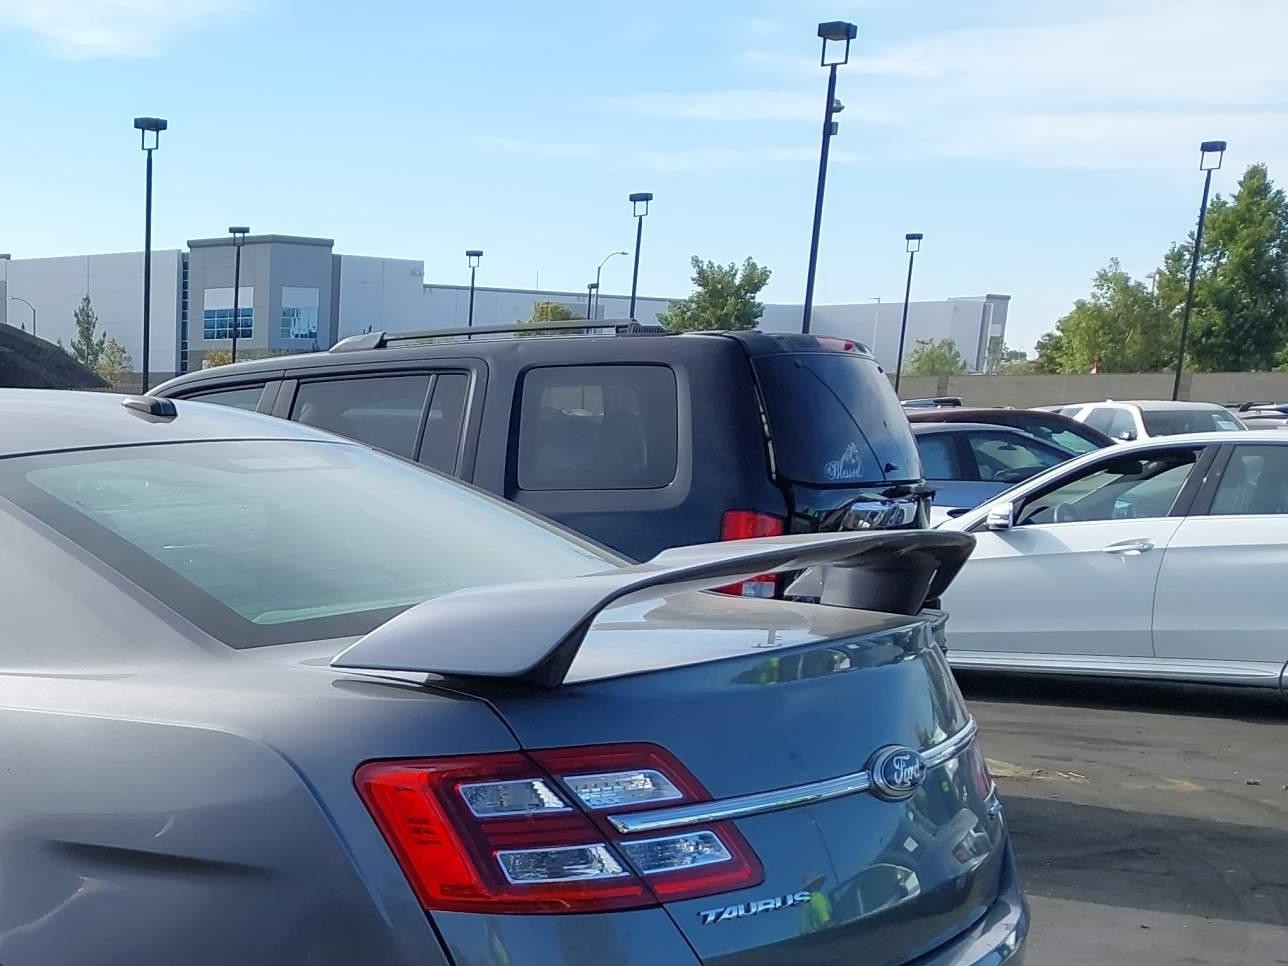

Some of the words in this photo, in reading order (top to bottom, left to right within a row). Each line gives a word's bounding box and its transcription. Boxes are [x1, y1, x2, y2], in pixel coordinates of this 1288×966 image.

[824, 458, 864, 480] Blessed
[892, 754, 921, 786] Ford
[700, 890, 812, 925] TAURUS
